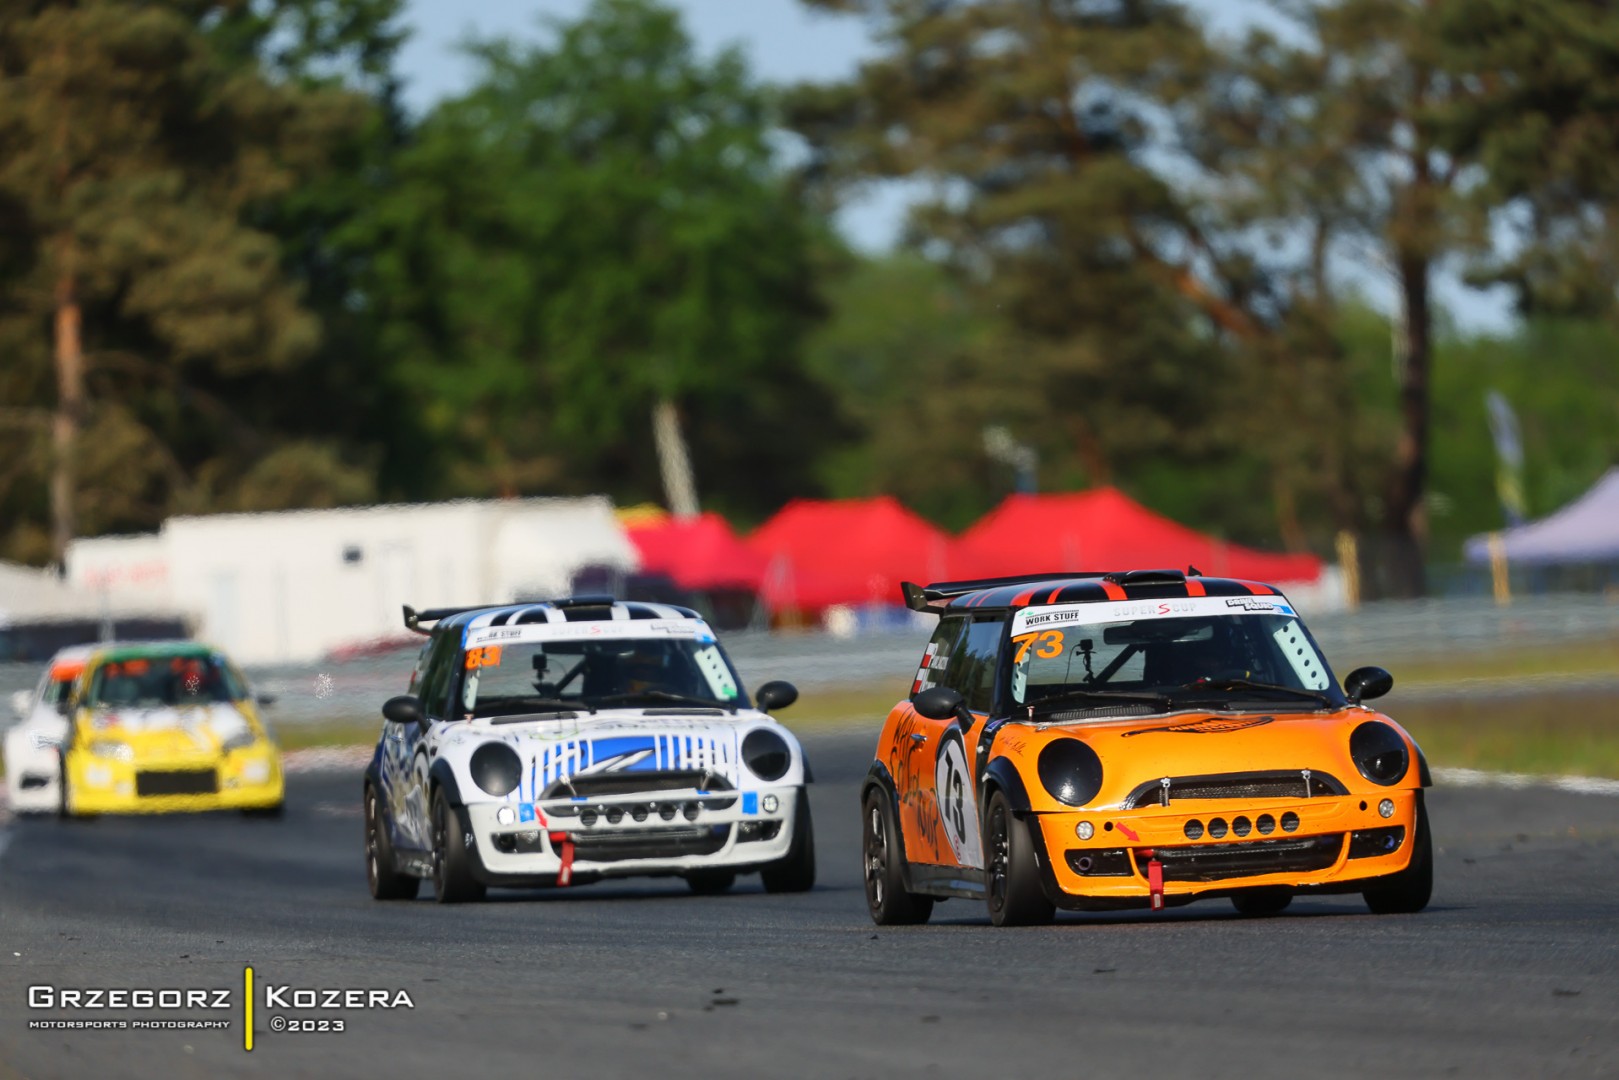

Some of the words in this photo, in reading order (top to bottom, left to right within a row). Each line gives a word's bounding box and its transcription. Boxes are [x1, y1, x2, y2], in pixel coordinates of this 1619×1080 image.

[1026, 614, 1051, 626] WORK
[1054, 612, 1079, 621] STUFF
[465, 645, 500, 669] 83
[1012, 630, 1065, 664] 73
